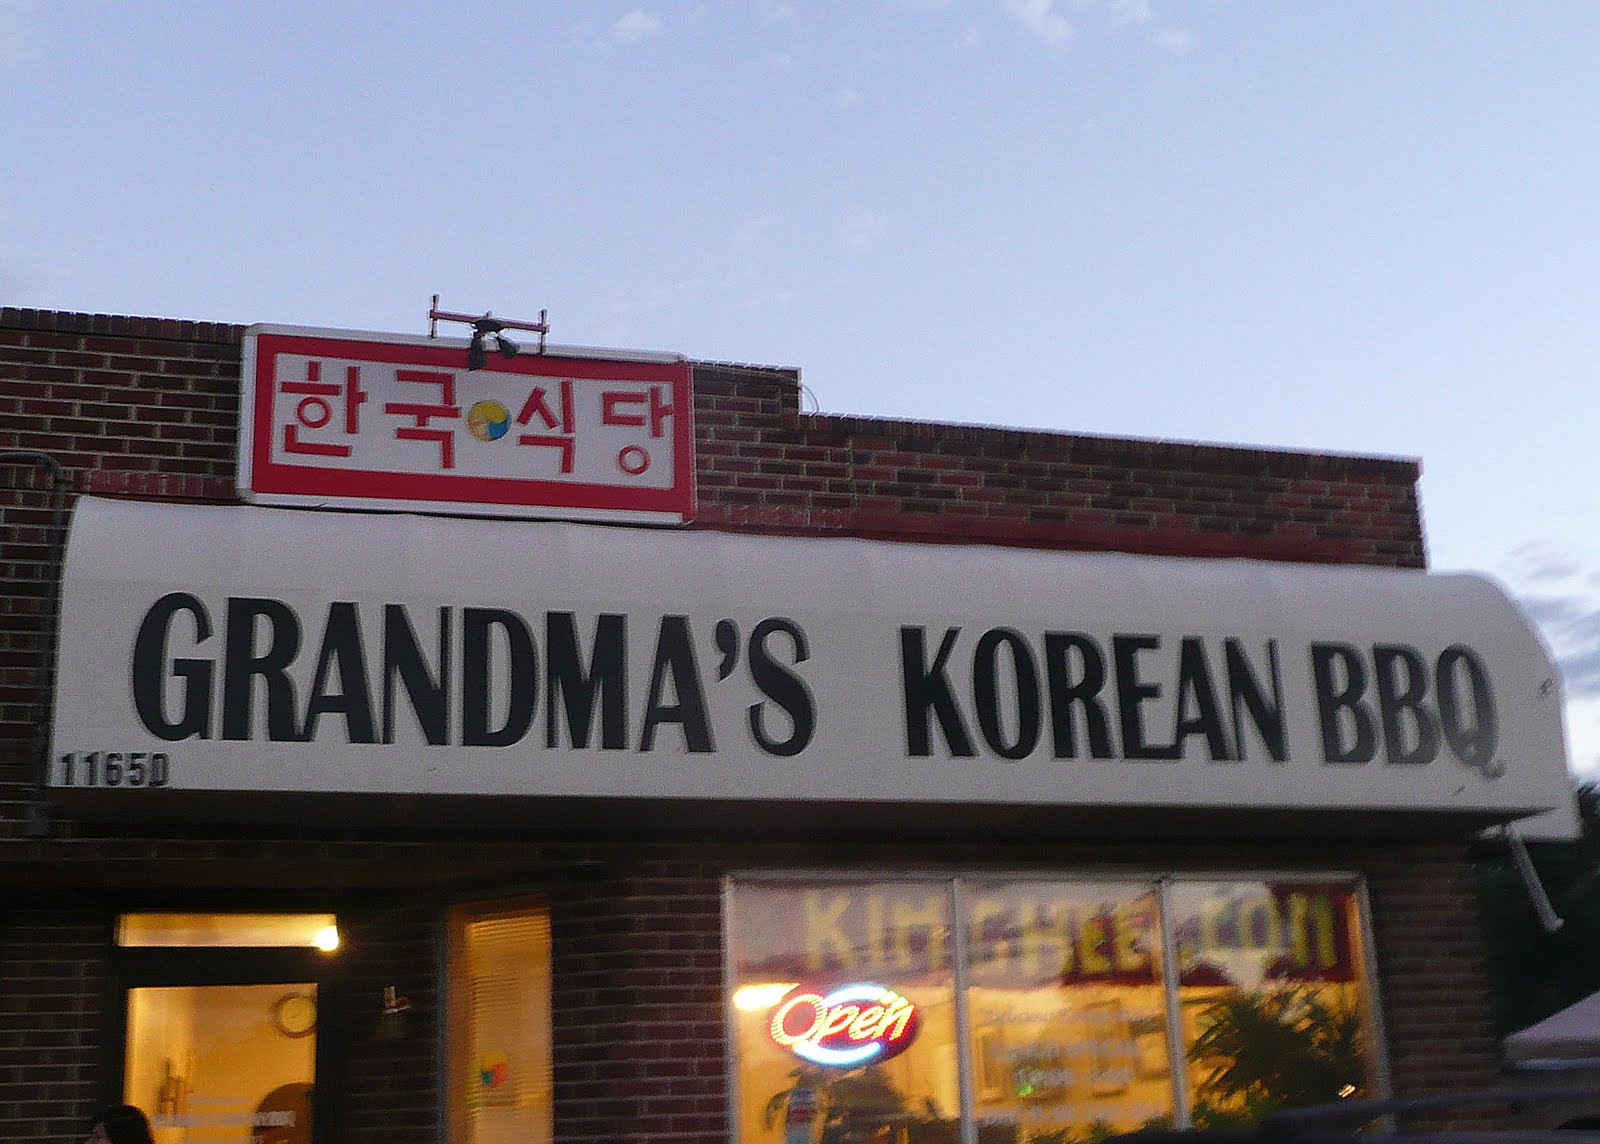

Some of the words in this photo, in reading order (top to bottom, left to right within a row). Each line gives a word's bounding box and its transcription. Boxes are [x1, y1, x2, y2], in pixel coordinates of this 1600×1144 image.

[132, 592, 818, 758] GRANDMA'S
[899, 625, 1290, 763] KOREAN
[1311, 640, 1506, 779] BBQ
[771, 993, 916, 1045] Open
